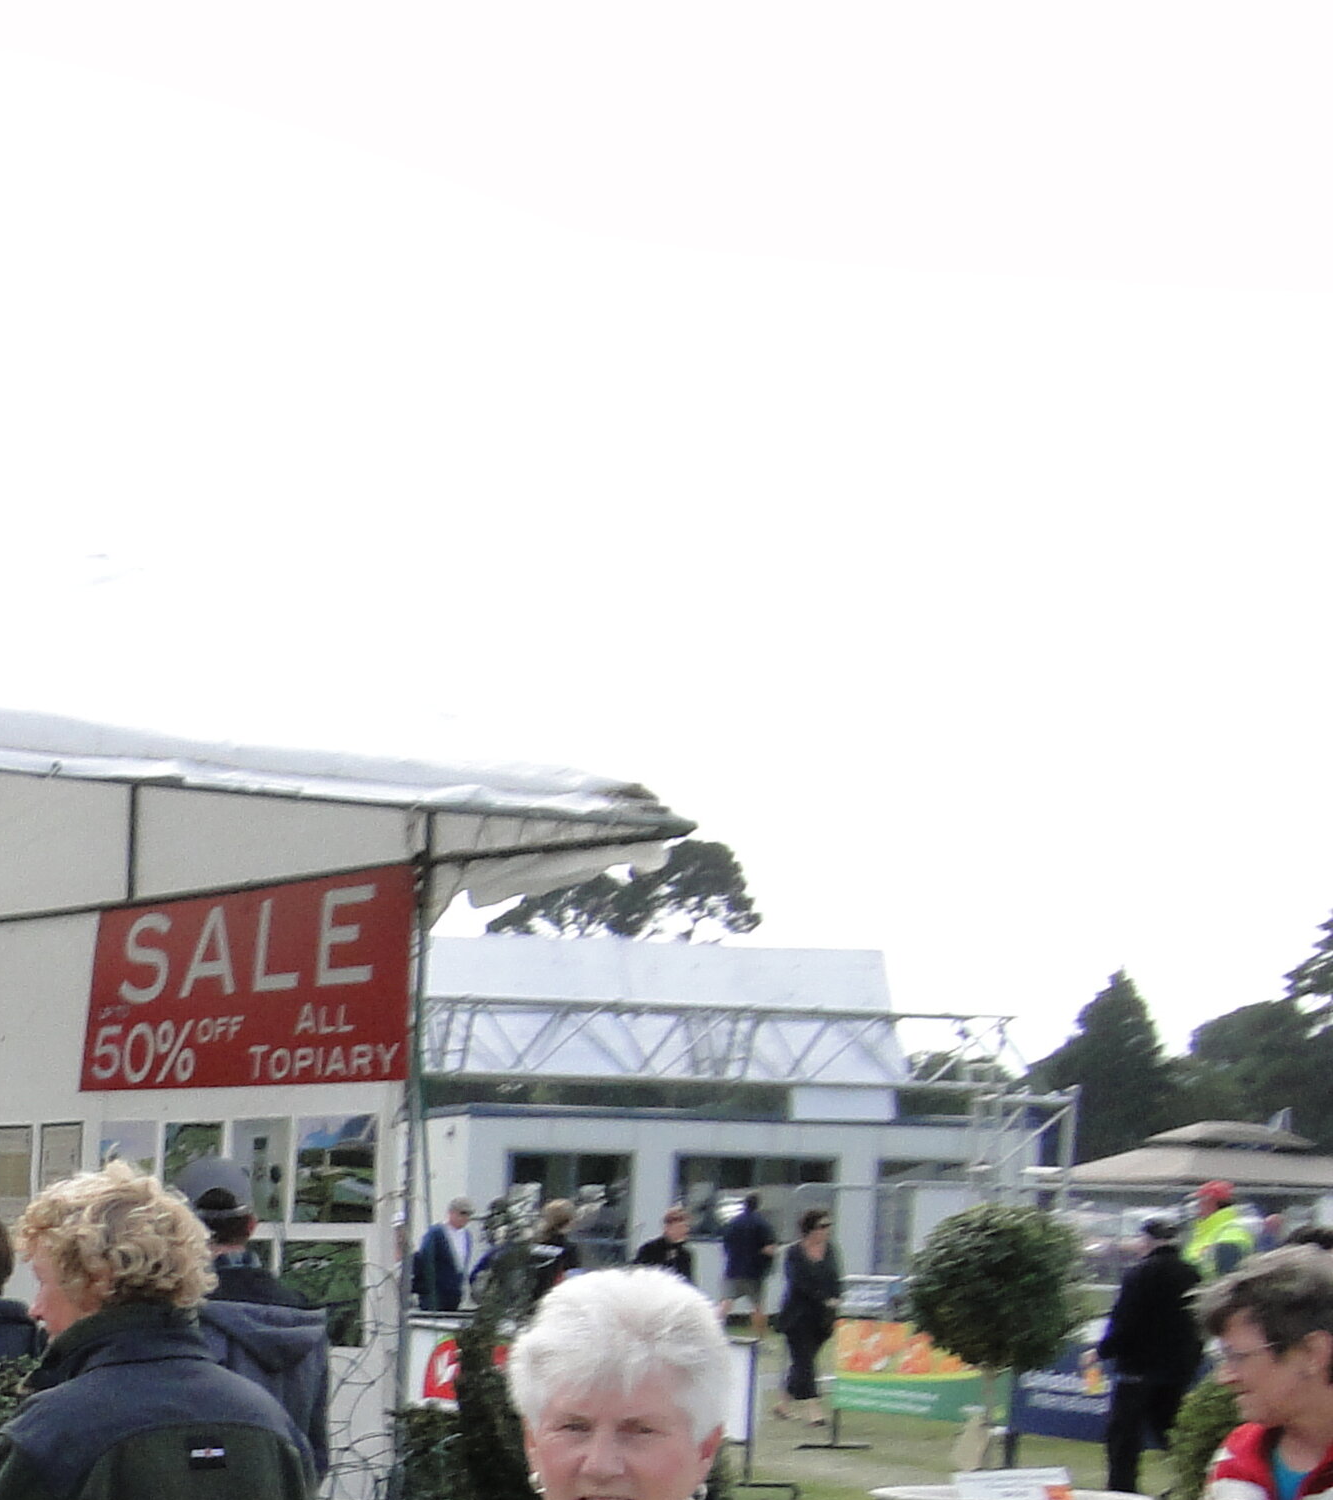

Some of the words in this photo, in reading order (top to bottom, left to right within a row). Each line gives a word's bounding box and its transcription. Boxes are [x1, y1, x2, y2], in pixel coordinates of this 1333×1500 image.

[118, 883, 377, 1005] SALE
[293, 1002, 355, 1036] ALL
[90, 1019, 195, 1084] 50%
[196, 1015, 244, 1044] OFF
[248, 1041, 401, 1081] TOPIARY
